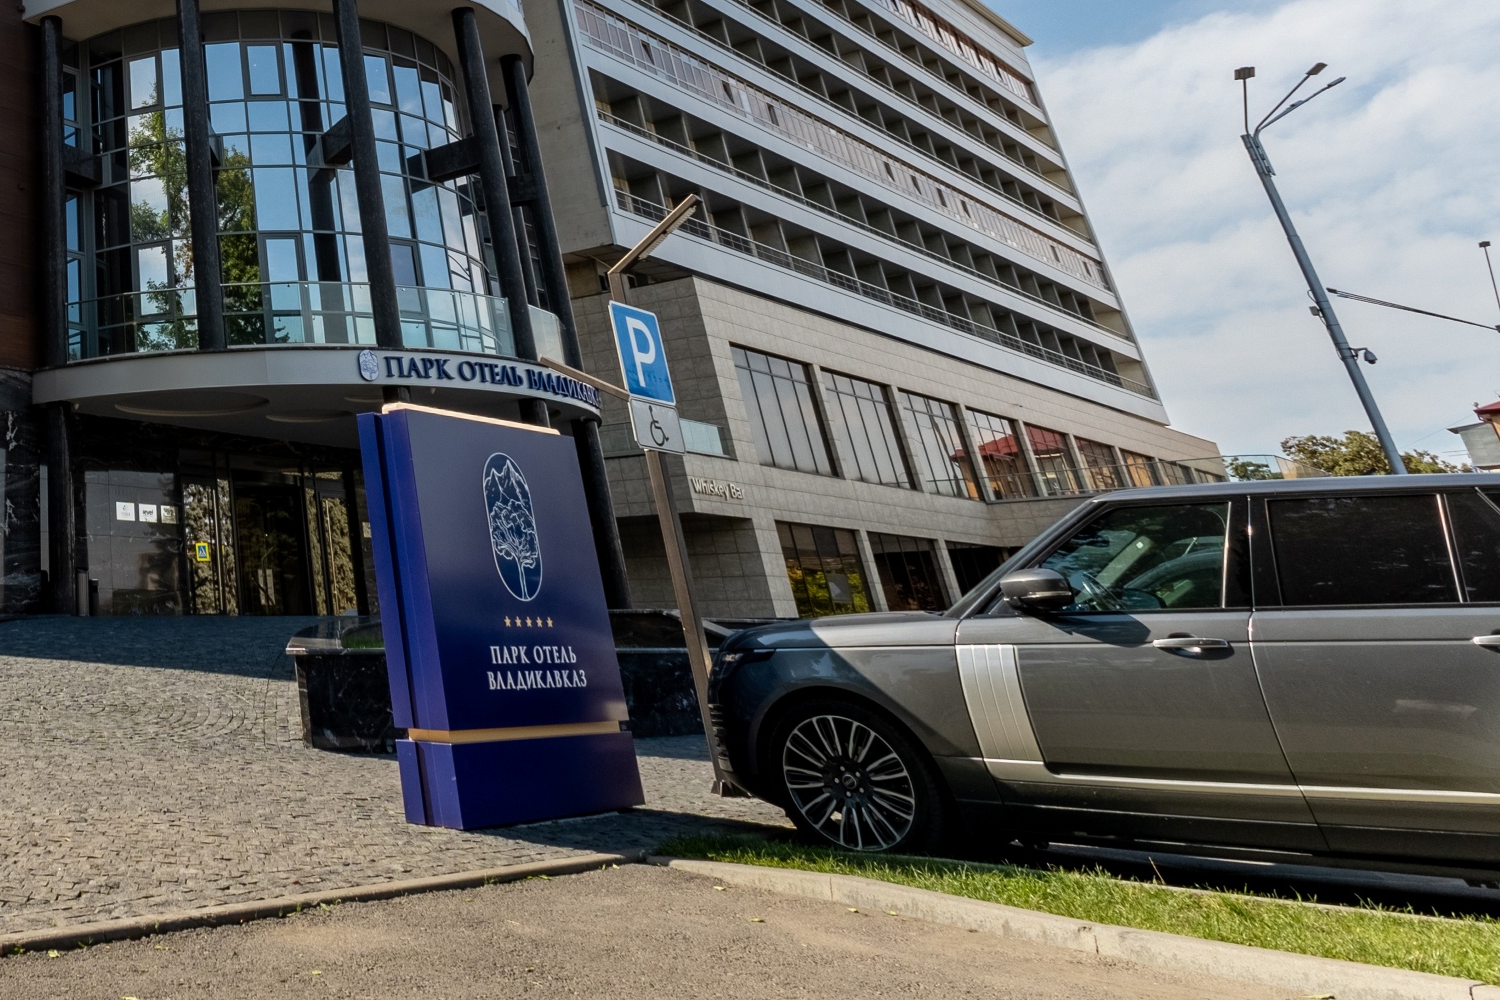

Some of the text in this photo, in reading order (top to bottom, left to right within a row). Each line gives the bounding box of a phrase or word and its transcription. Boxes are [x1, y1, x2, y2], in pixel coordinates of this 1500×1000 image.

[625, 316, 656, 388] P
[384, 355, 454, 380] ПАРК
[457, 360, 524, 387] ОТЕЛЬ
[691, 478, 745, 501] Whiskey Bar
[490, 645, 577, 664] ПАРК ОТЕЛЬ
[486, 669, 587, 691] ВЛАДИКАВКАЗ
